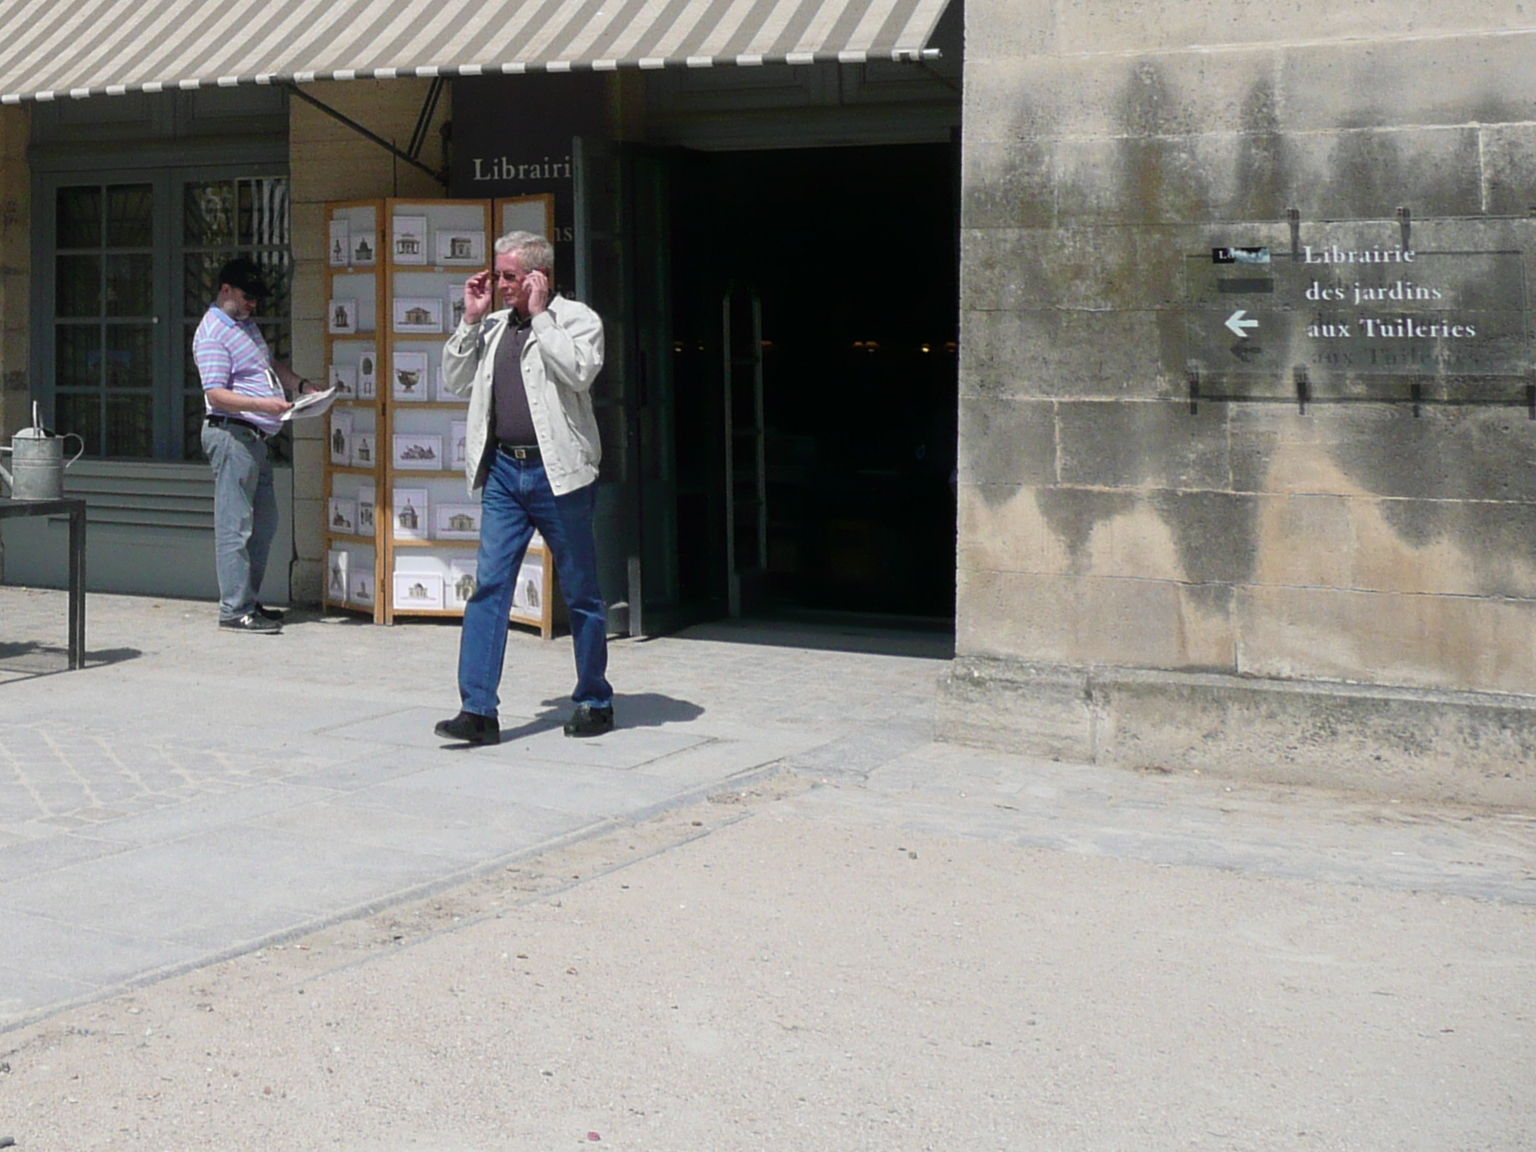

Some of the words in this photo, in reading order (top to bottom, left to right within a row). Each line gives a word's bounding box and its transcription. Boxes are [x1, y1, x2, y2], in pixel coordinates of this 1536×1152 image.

[473, 156, 572, 181] Librairi
[1303, 244, 1416, 264] Librairie
[1305, 281, 1345, 301] des
[1354, 280, 1442, 306] jardins
[1307, 323, 1351, 338] aux
[1359, 318, 1477, 338] Tuileries
